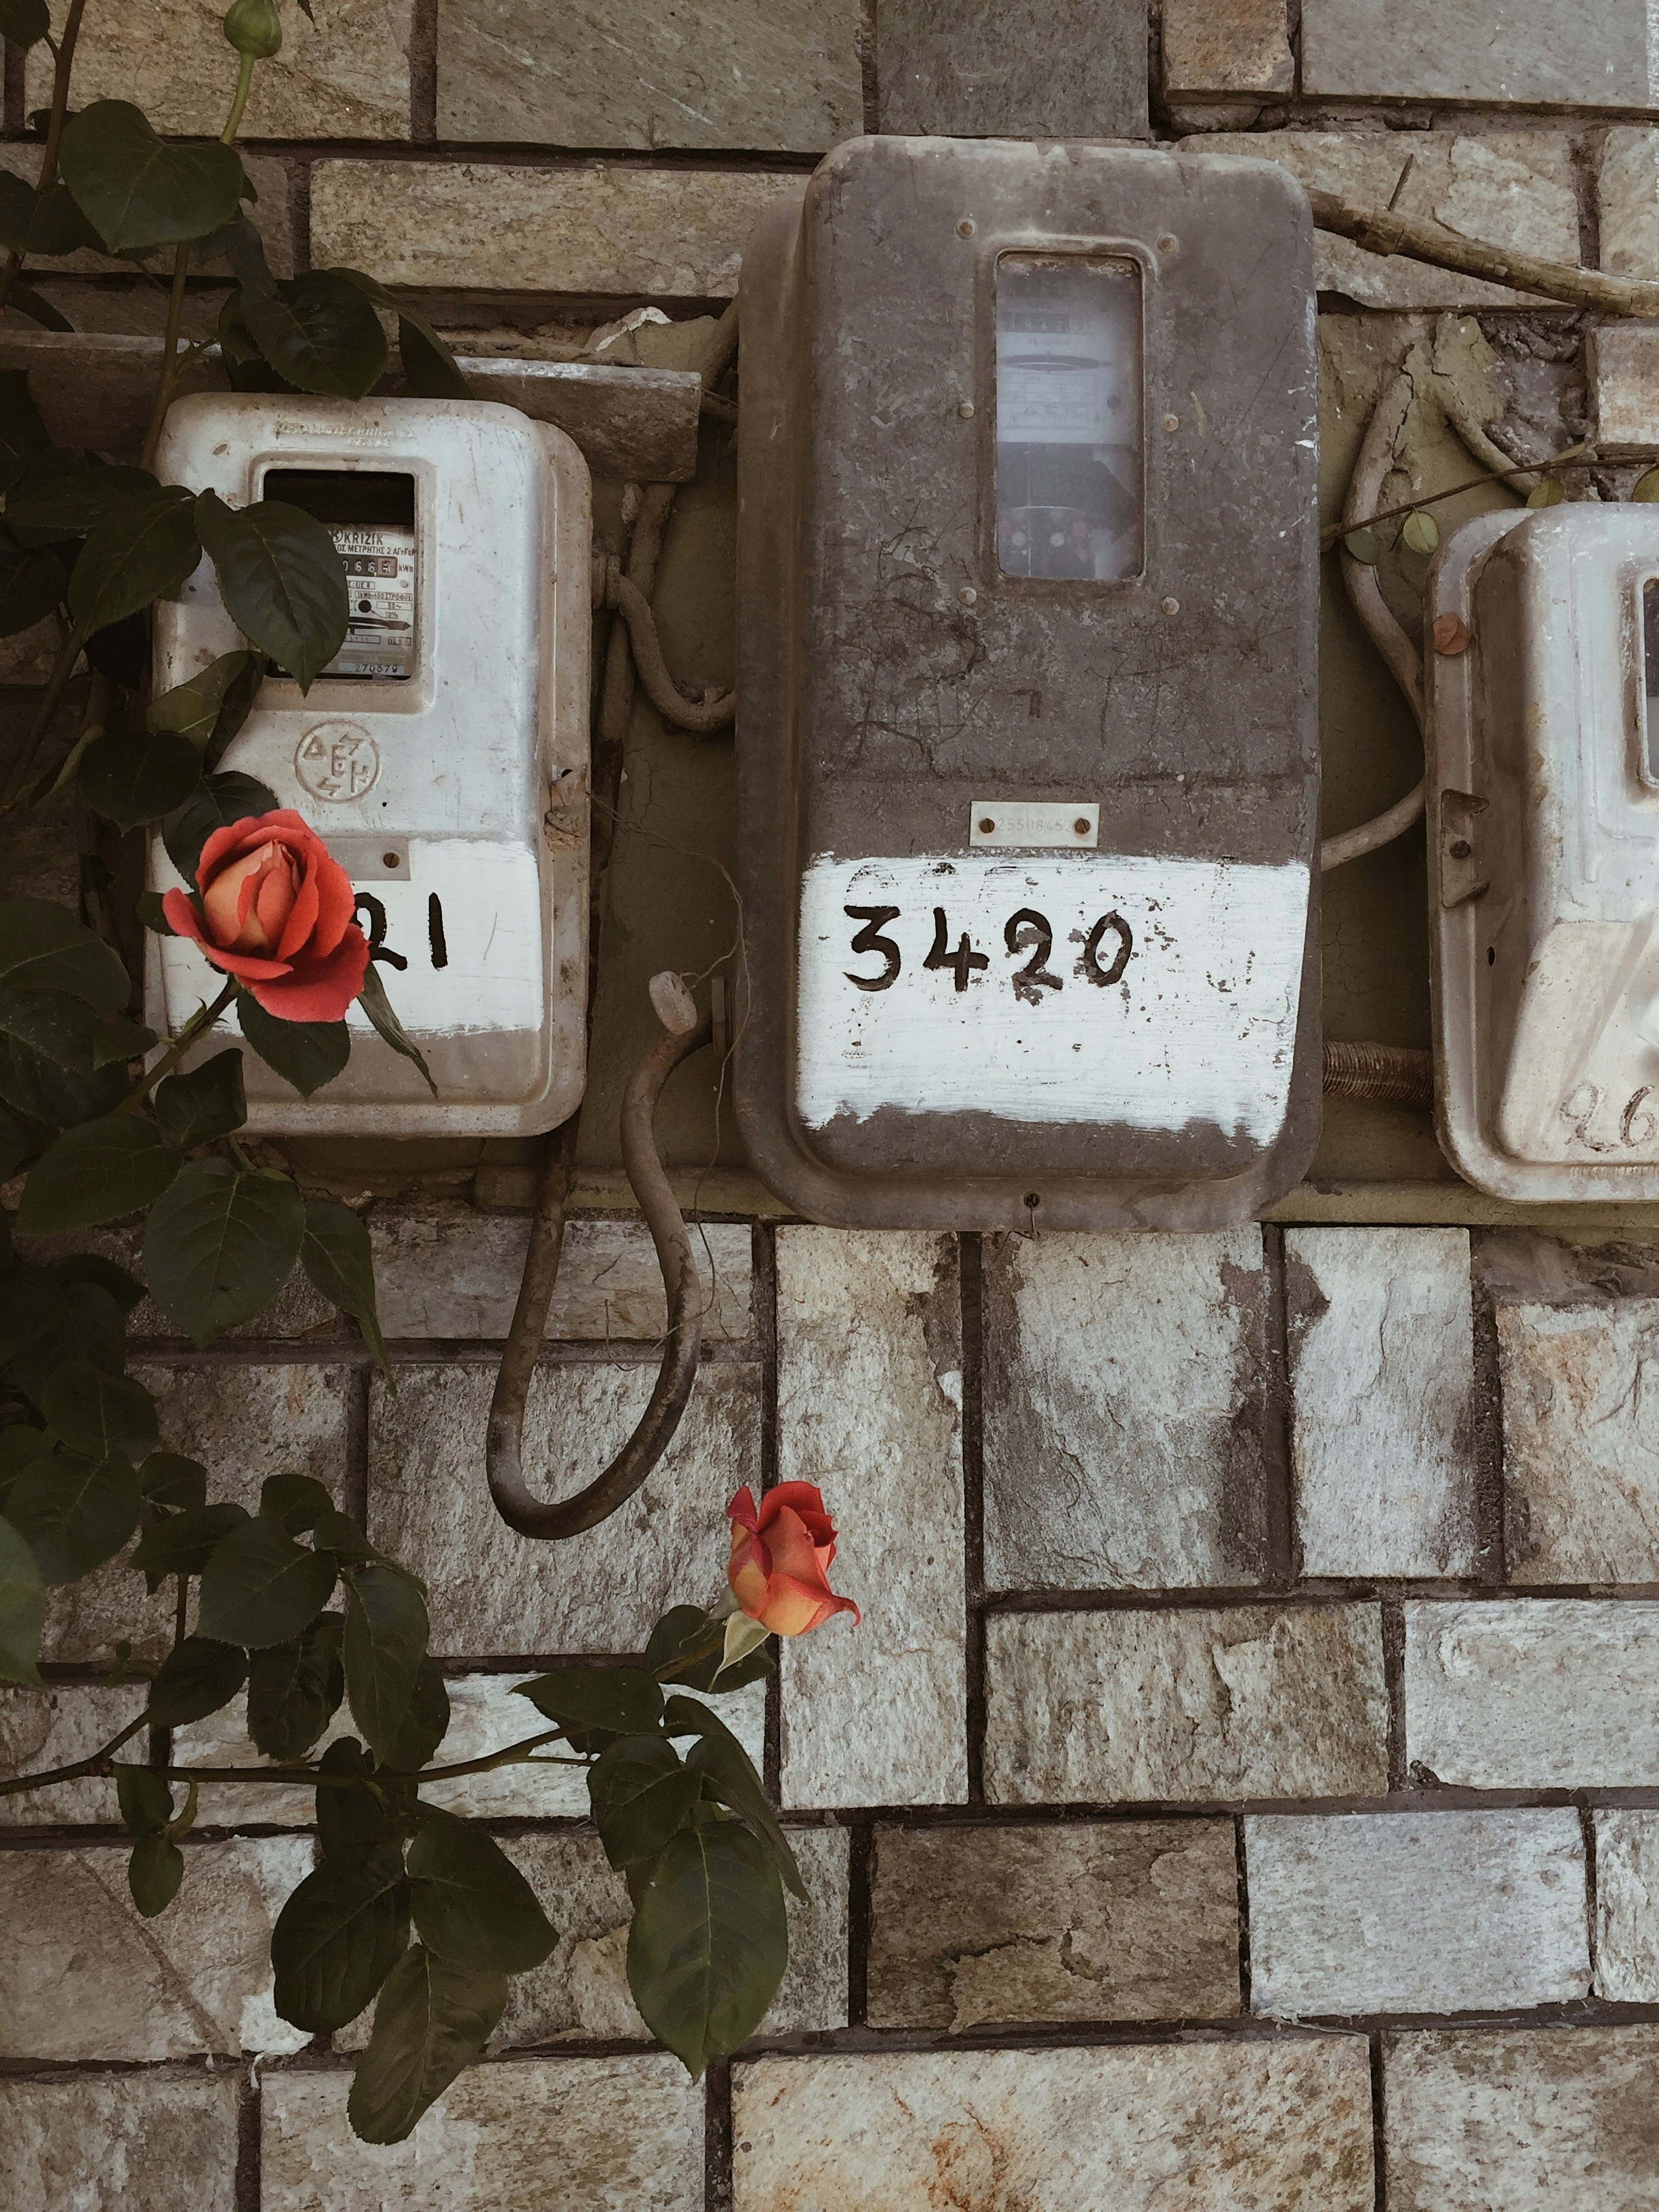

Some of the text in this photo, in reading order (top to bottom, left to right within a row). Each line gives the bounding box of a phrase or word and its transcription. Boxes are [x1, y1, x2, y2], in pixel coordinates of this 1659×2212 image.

[348, 545, 385, 554] ΜΕΤΡΗΤΗΣ
[386, 547, 391, 555] 2
[398, 564, 413, 573] kWh
[354, 664, 398, 673] 270379
[350, 891, 448, 970] 21
[842, 905, 1132, 992] 3420
